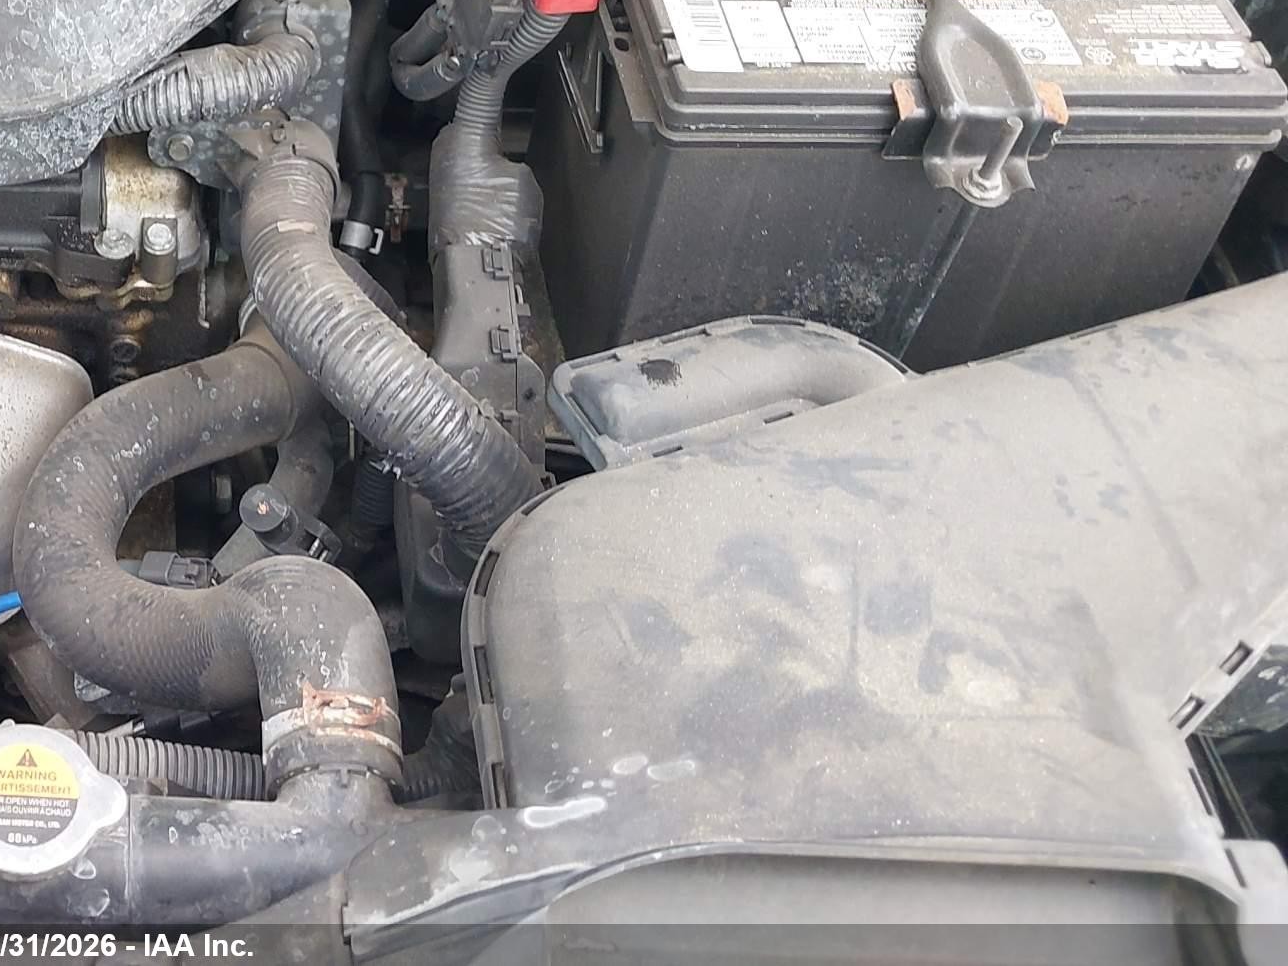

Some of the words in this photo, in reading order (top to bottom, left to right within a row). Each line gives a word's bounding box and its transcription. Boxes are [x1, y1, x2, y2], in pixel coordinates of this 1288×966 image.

[6, 797, 27, 806] OPEN
[28, 798, 52, 807] WHEN
[45, 808, 72, 817] CHAUD
